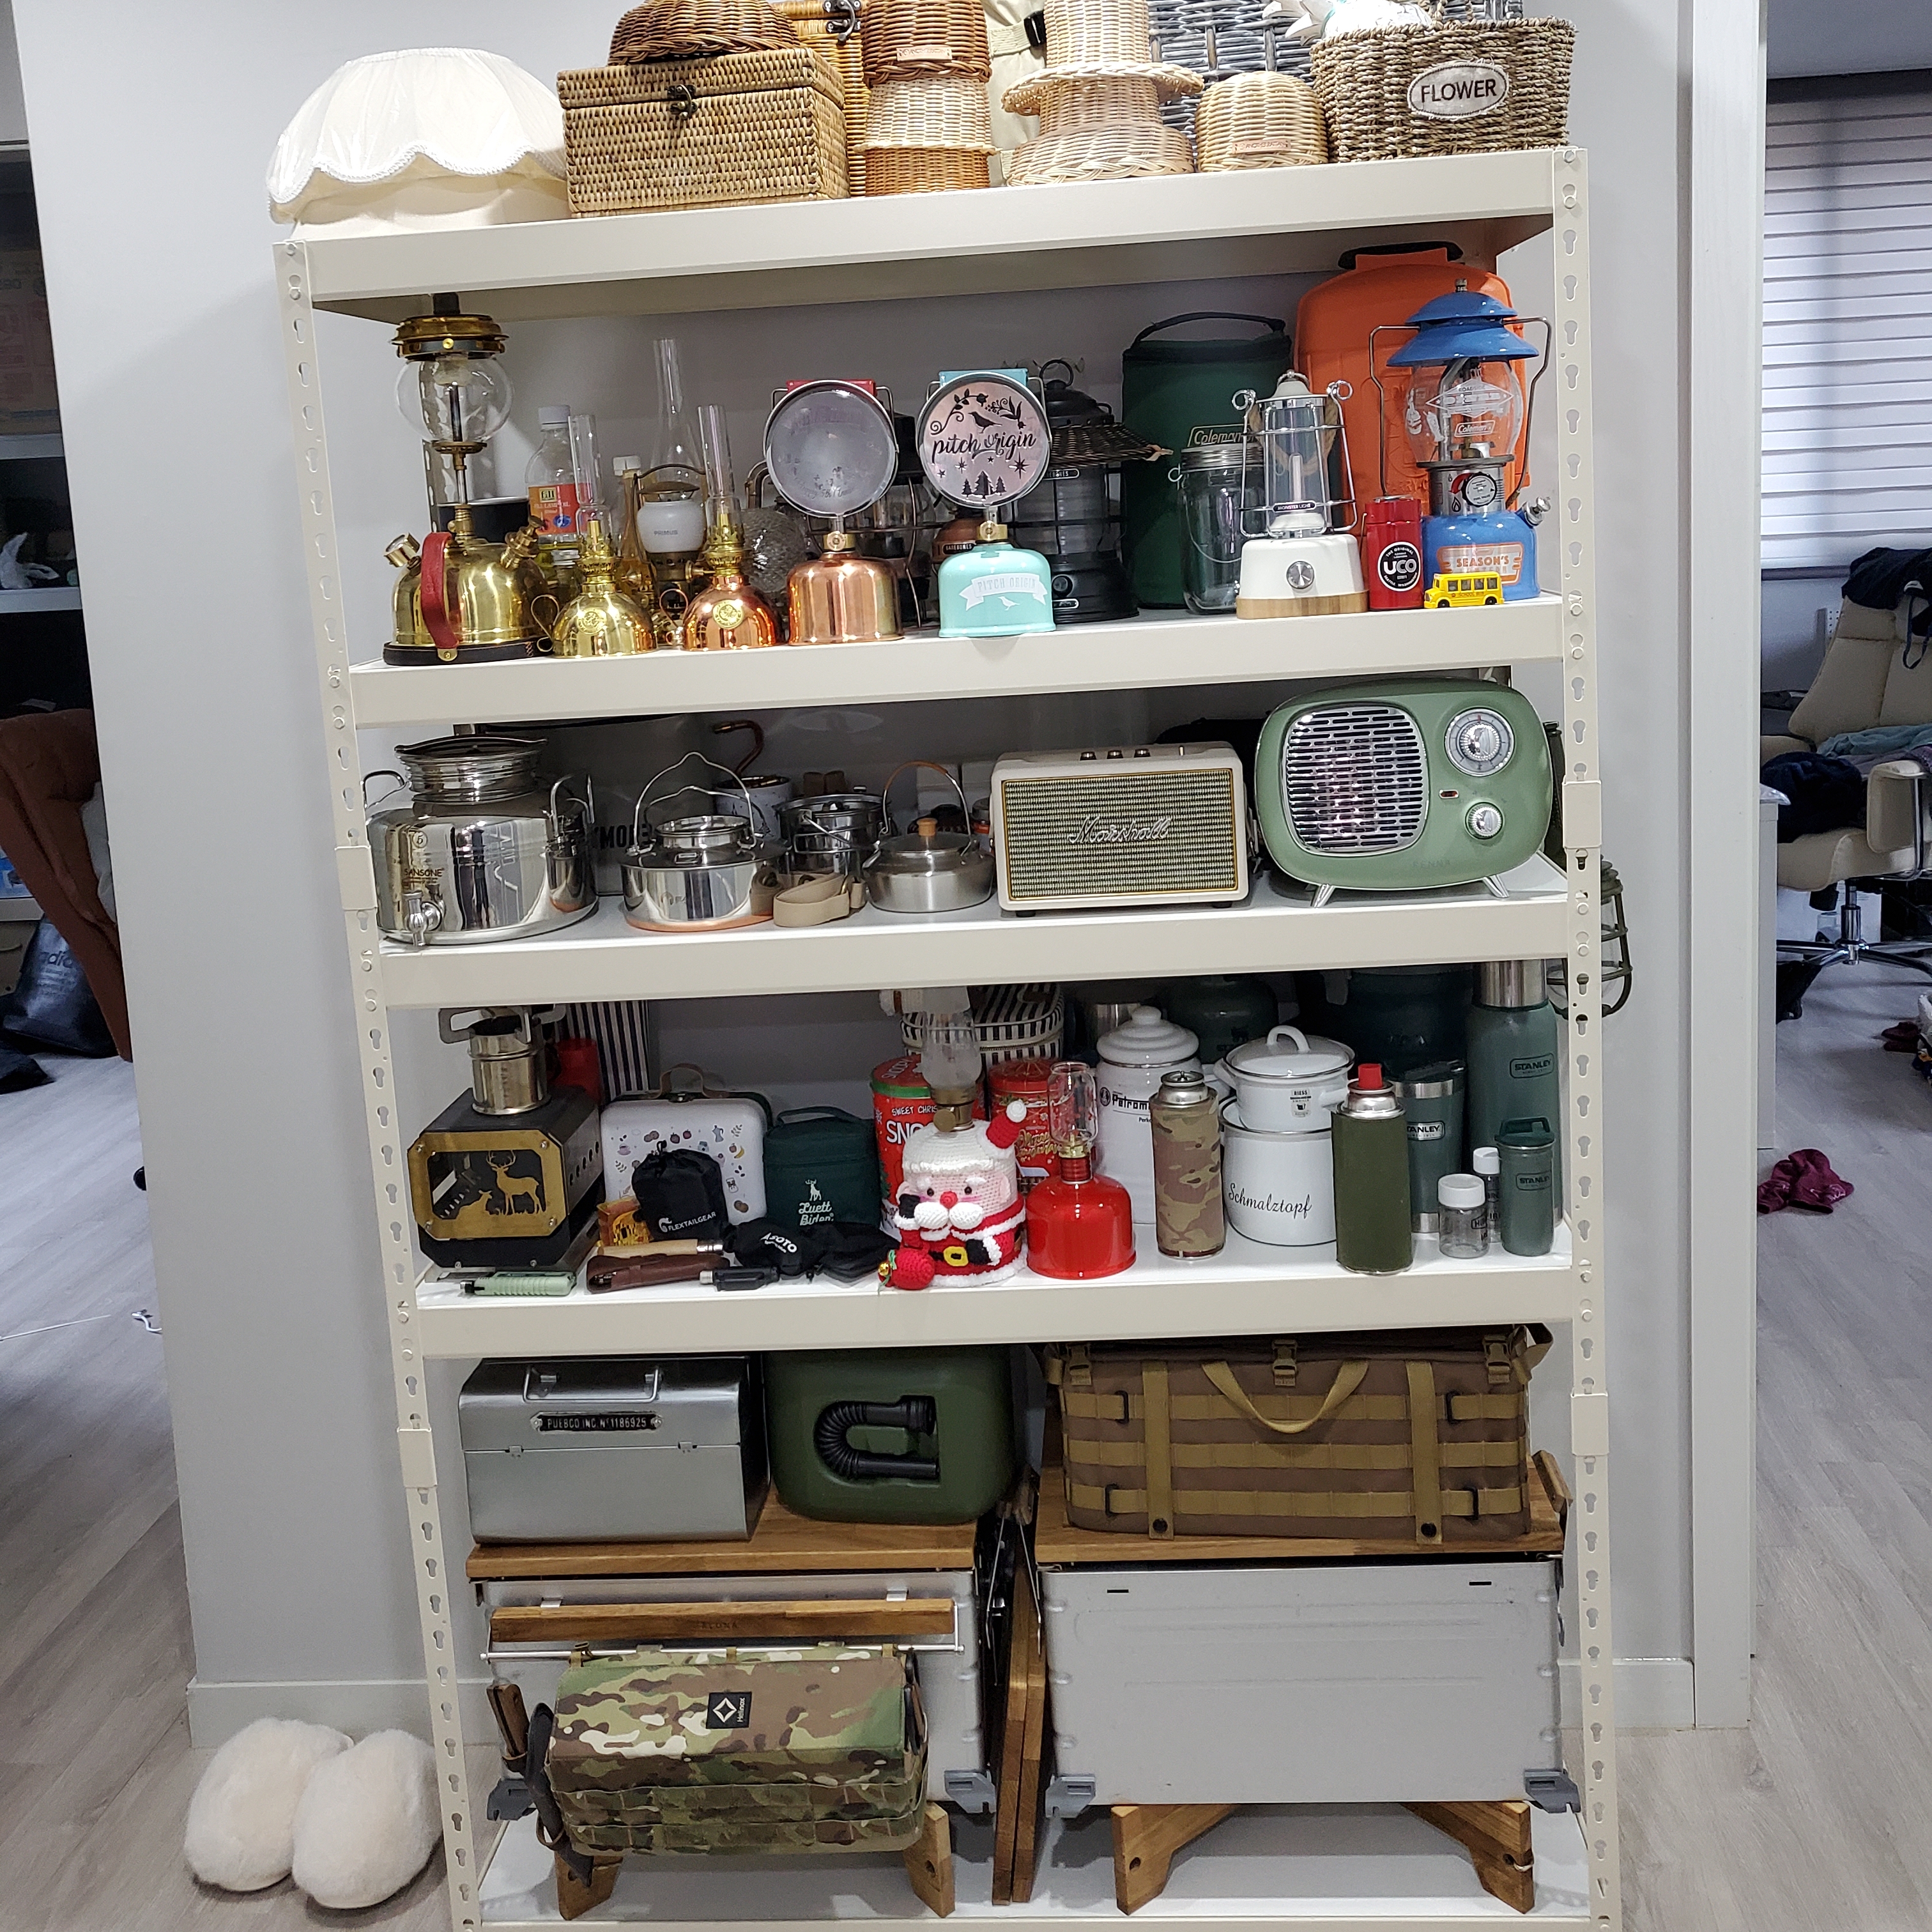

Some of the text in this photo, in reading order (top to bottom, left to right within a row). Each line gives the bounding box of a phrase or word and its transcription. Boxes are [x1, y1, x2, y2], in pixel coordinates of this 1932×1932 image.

[1421, 79, 1497, 103] FLOWER
[1458, 424, 1487, 433] Coleman
[1194, 429, 1243, 445] Coleman
[932, 432, 1036, 464] pitch origin
[1383, 558, 1417, 575] UCO
[1456, 555, 1510, 567] SEASON'S
[977, 577, 1036, 592] PITCH ORIGIN
[1068, 815, 1171, 843] Marshall
[404, 868, 443, 877] SANSONE
[1514, 1059, 1551, 1071] STANLEY
[1112, 1094, 1151, 1110] Petrom
[891, 1106, 914, 1117] SWEET
[1407, 1125, 1440, 1133] TANLEY
[1228, 1183, 1312, 1220] Schmalztopf
[668, 1211, 716, 1231] FLEXTAILGEAR
[548, 1418, 580, 1429] PUEBCO
[737, 1697, 746, 1723] Helinox
